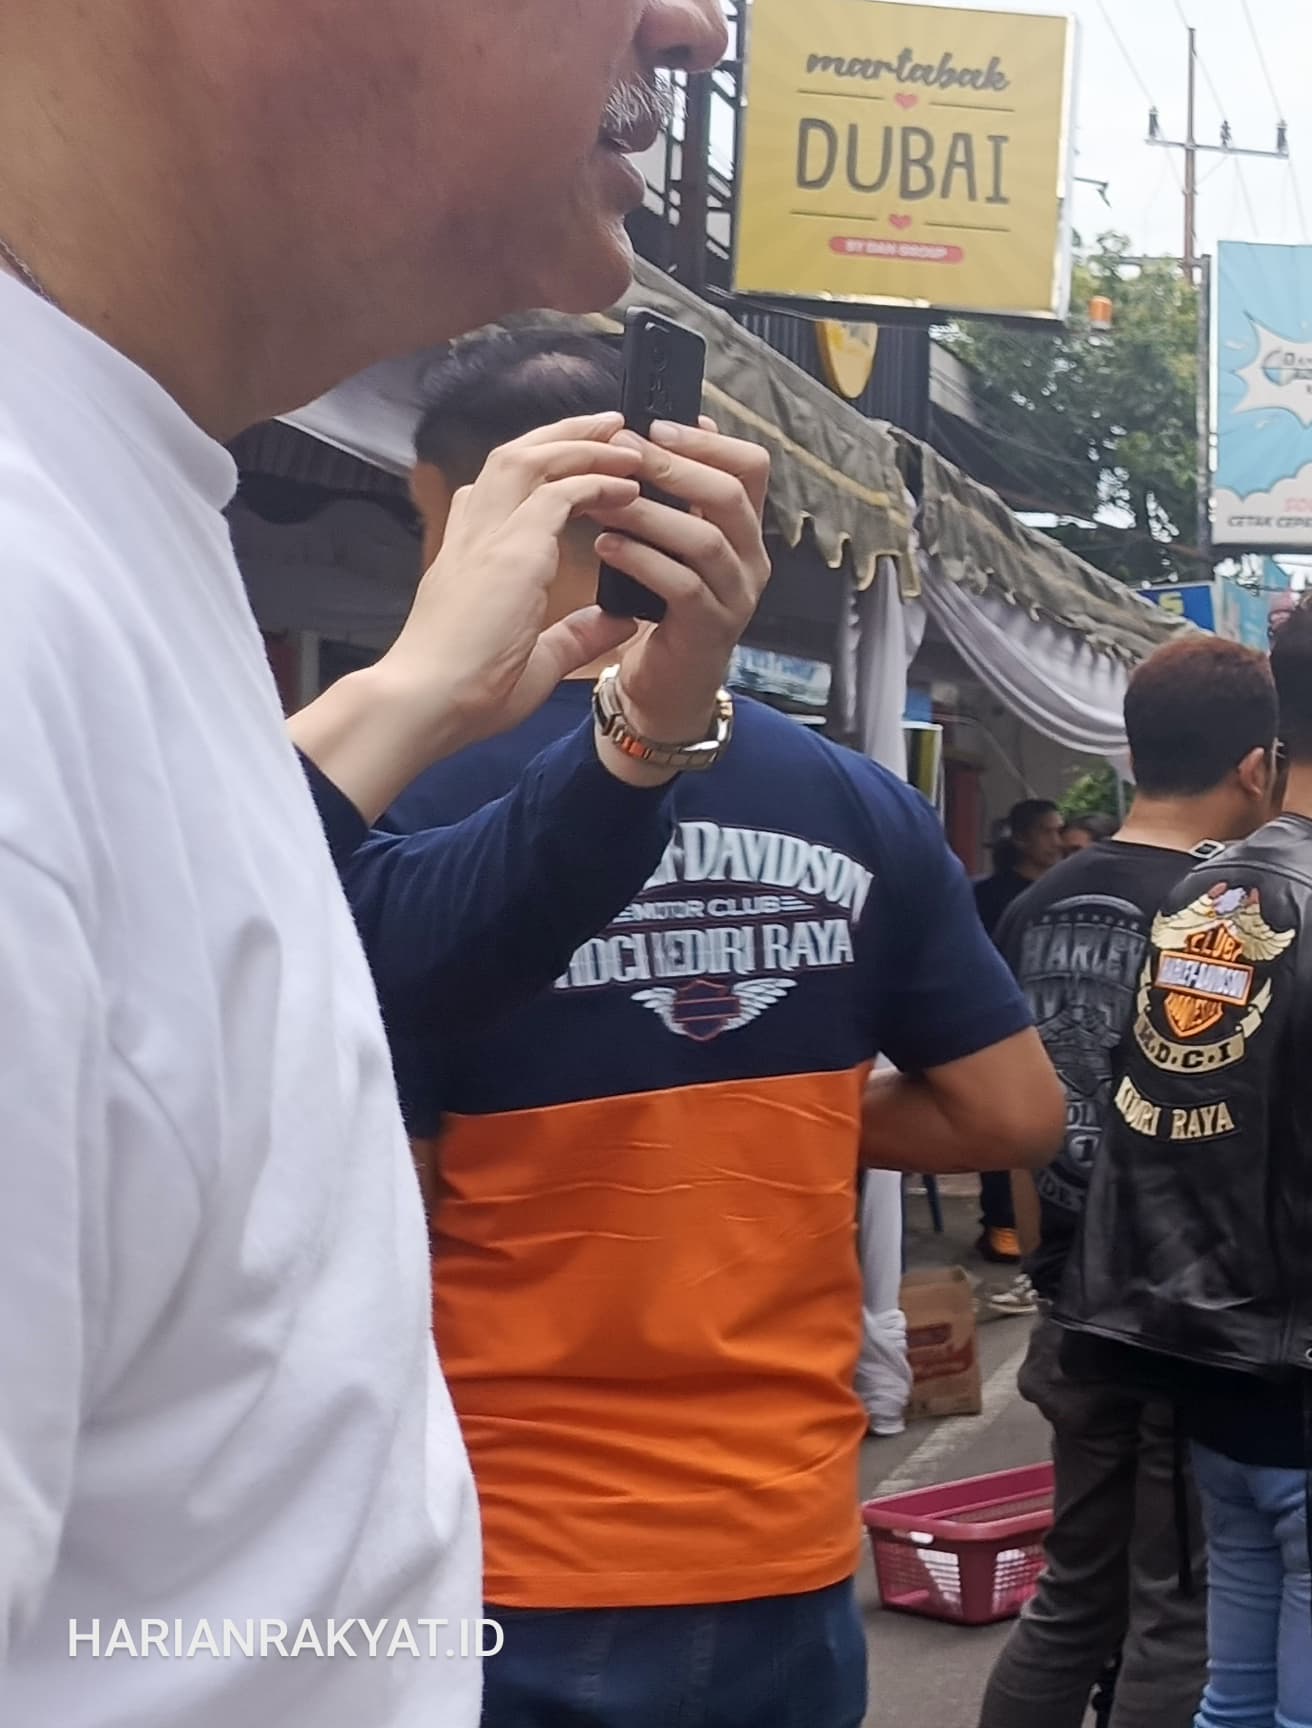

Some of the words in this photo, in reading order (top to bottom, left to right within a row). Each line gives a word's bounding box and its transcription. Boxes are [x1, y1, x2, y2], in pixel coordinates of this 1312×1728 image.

[806, 48, 1011, 91] martabak
[796, 117, 1010, 204] DUBAI
[643, 821, 874, 924] -DAVIDSON
[706, 895, 782, 916] CLUB
[762, 918, 855, 972] RAYA
[1170, 1101, 1235, 1140] RAYA
